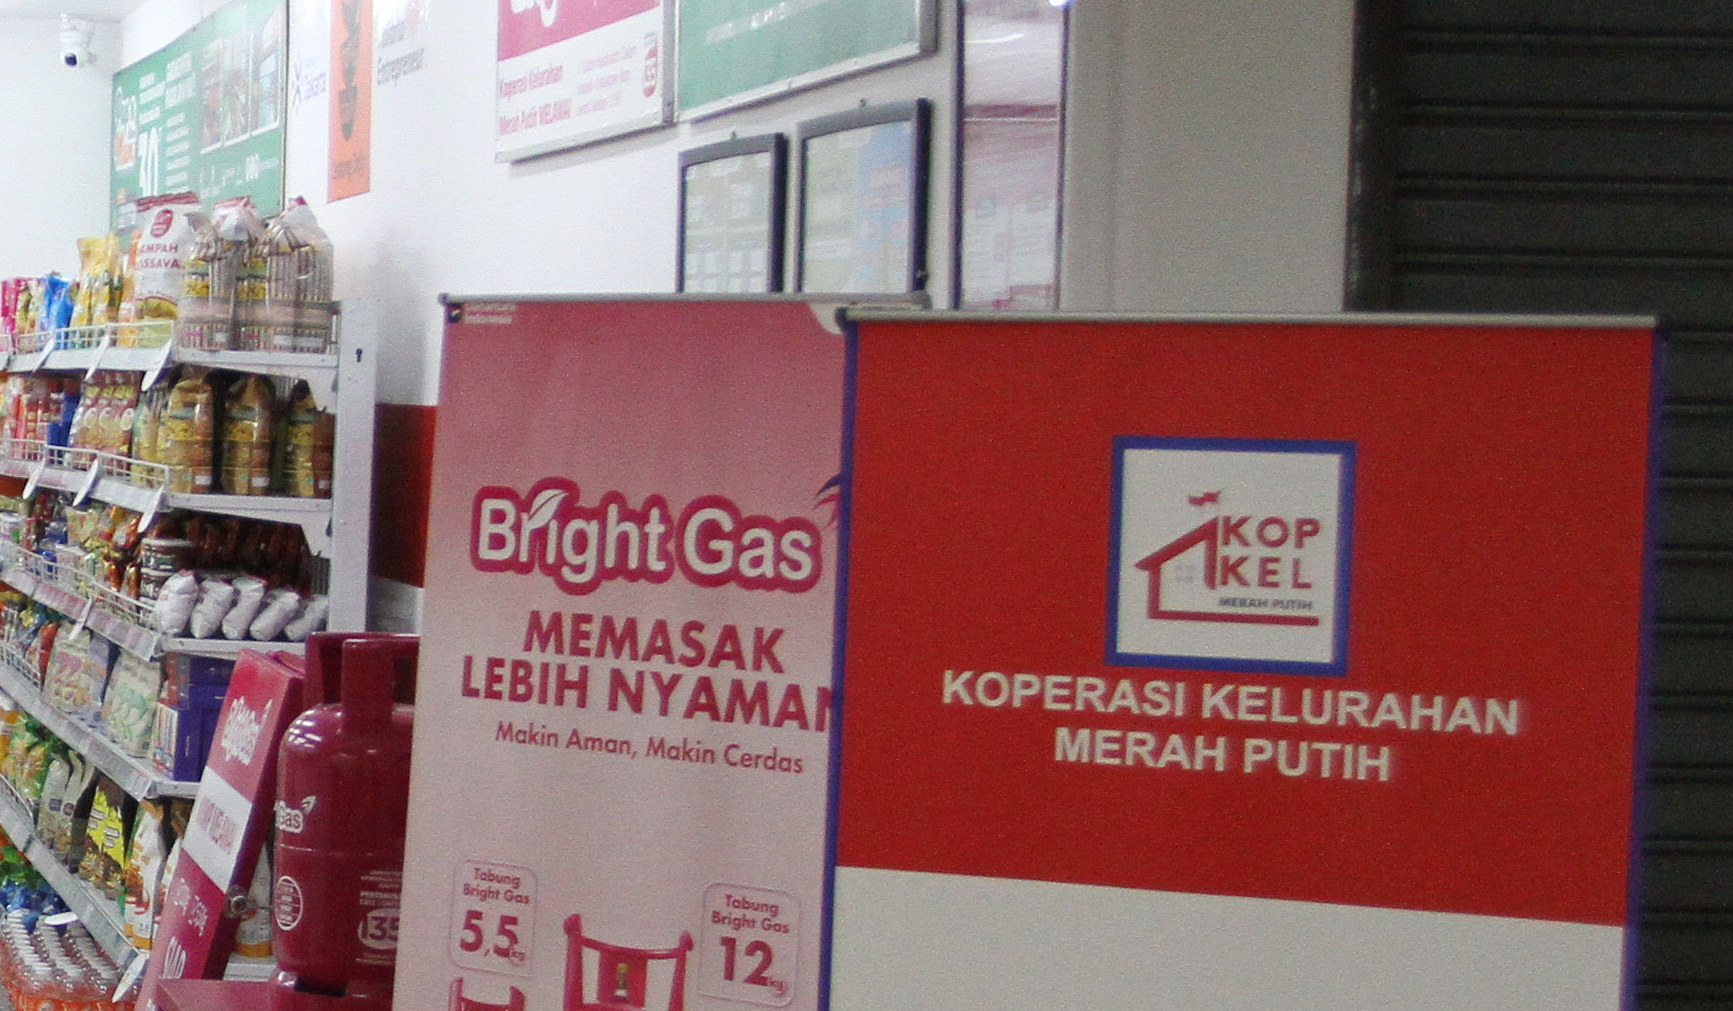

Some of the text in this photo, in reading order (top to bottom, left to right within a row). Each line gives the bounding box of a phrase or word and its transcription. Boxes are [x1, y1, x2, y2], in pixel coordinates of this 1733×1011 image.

[476, 487, 815, 586] Bright Gas
[1220, 514, 1323, 551] KOP
[1220, 555, 1314, 590] KEL
[1219, 597, 1314, 610] MERAH PUTIH
[523, 609, 786, 675] MEMASAK
[461, 655, 590, 710] LEBIH
[940, 669, 1522, 737] KOPERASI KELURAHAN
[495, 720, 804, 775] Makin Aman, Makin Cerdas
[1053, 725, 1392, 784] MERAH PUTIH
[462, 883, 531, 905] Bright Gas
[473, 867, 521, 889] Tabung
[710, 909, 791, 935] Bright Gas
[724, 893, 780, 918] Tabung
[459, 909, 519, 959] 5,5
[719, 935, 775, 987] 12
